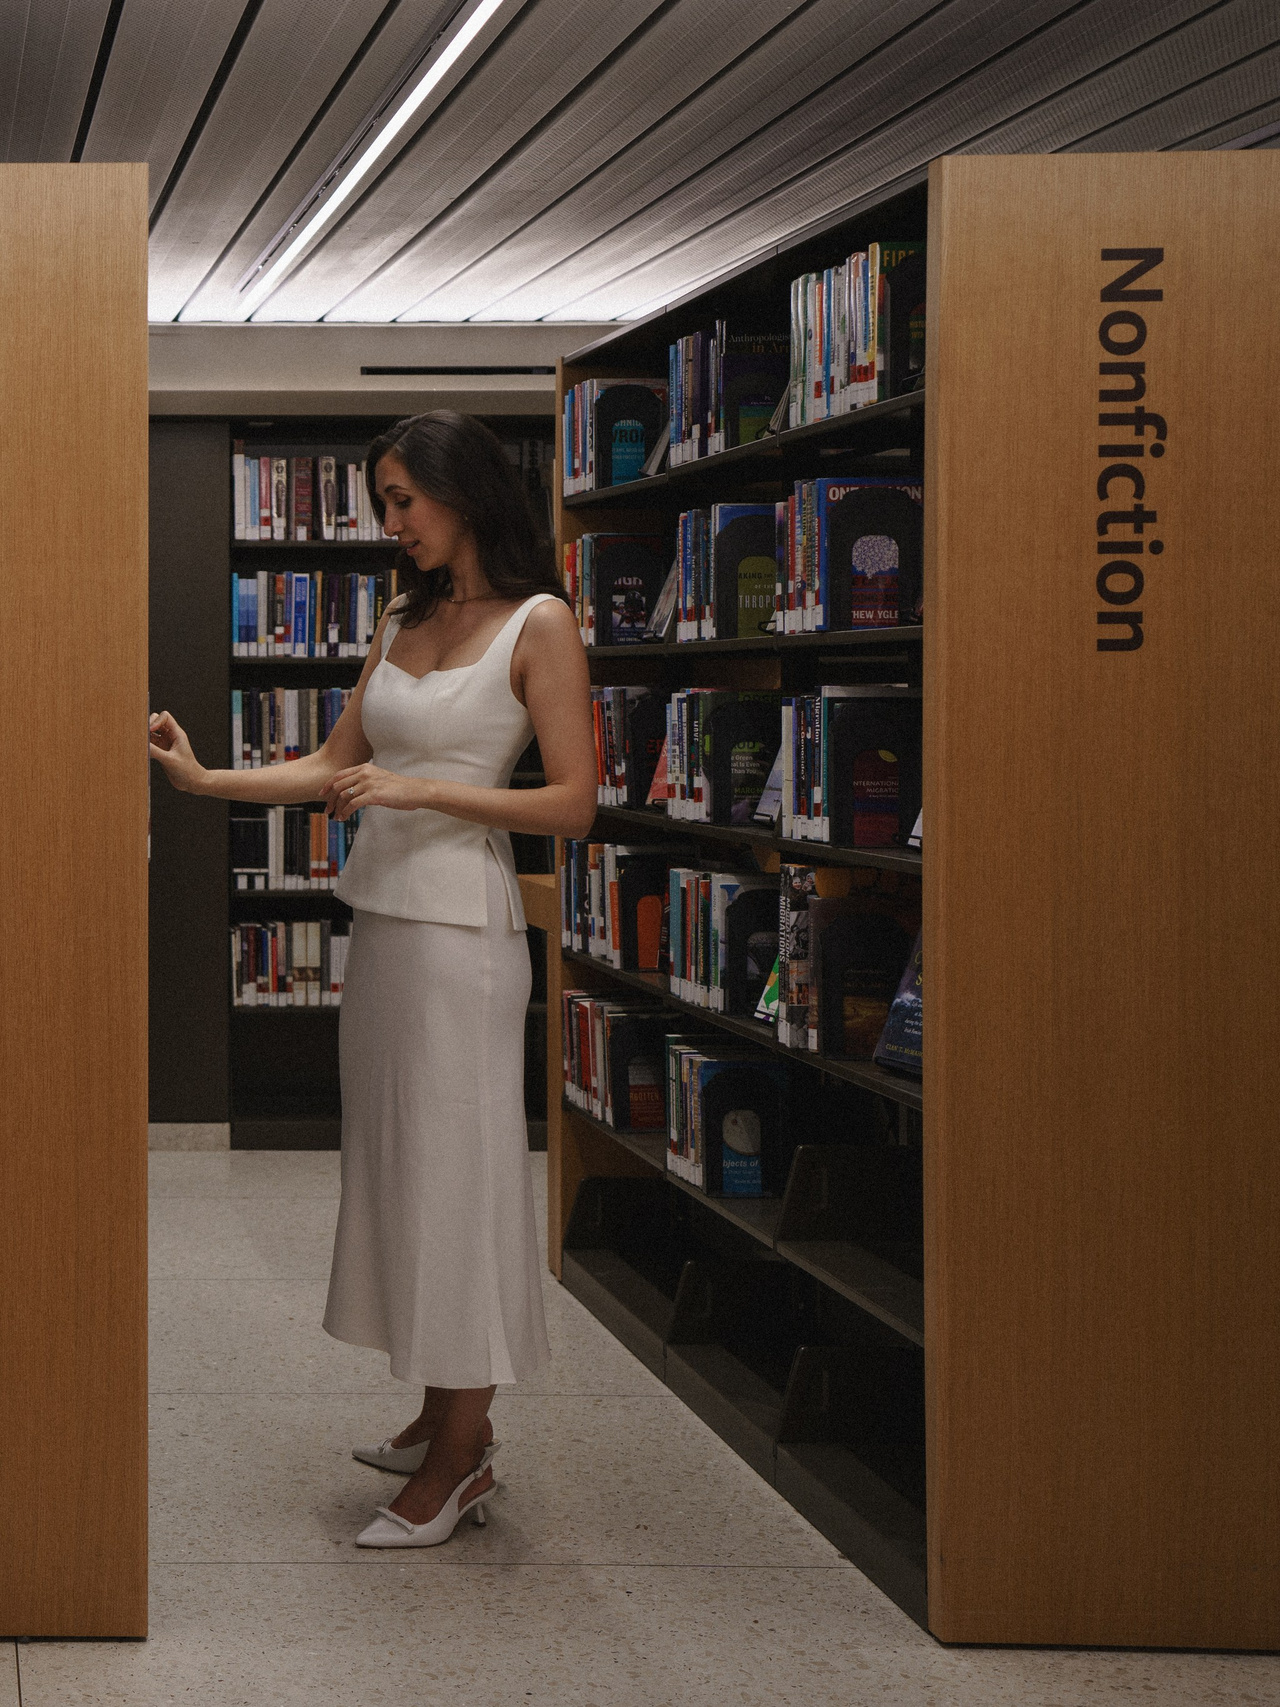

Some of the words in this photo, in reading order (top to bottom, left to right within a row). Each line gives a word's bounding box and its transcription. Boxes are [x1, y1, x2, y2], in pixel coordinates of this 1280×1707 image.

[883, 249, 915, 268] FIR
[728, 333, 790, 344] Anthropologis
[752, 343, 765, 353] in
[1096, 247, 1168, 652] Nonfiction
[828, 486, 859, 501] ON
[738, 595, 777, 609] THROPO
[877, 610, 899, 619] YGLE
[885, 1043, 899, 1052] CIAN
[629, 1092, 659, 1101] RGOTTEN
[722, 1160, 747, 1168] bjects
